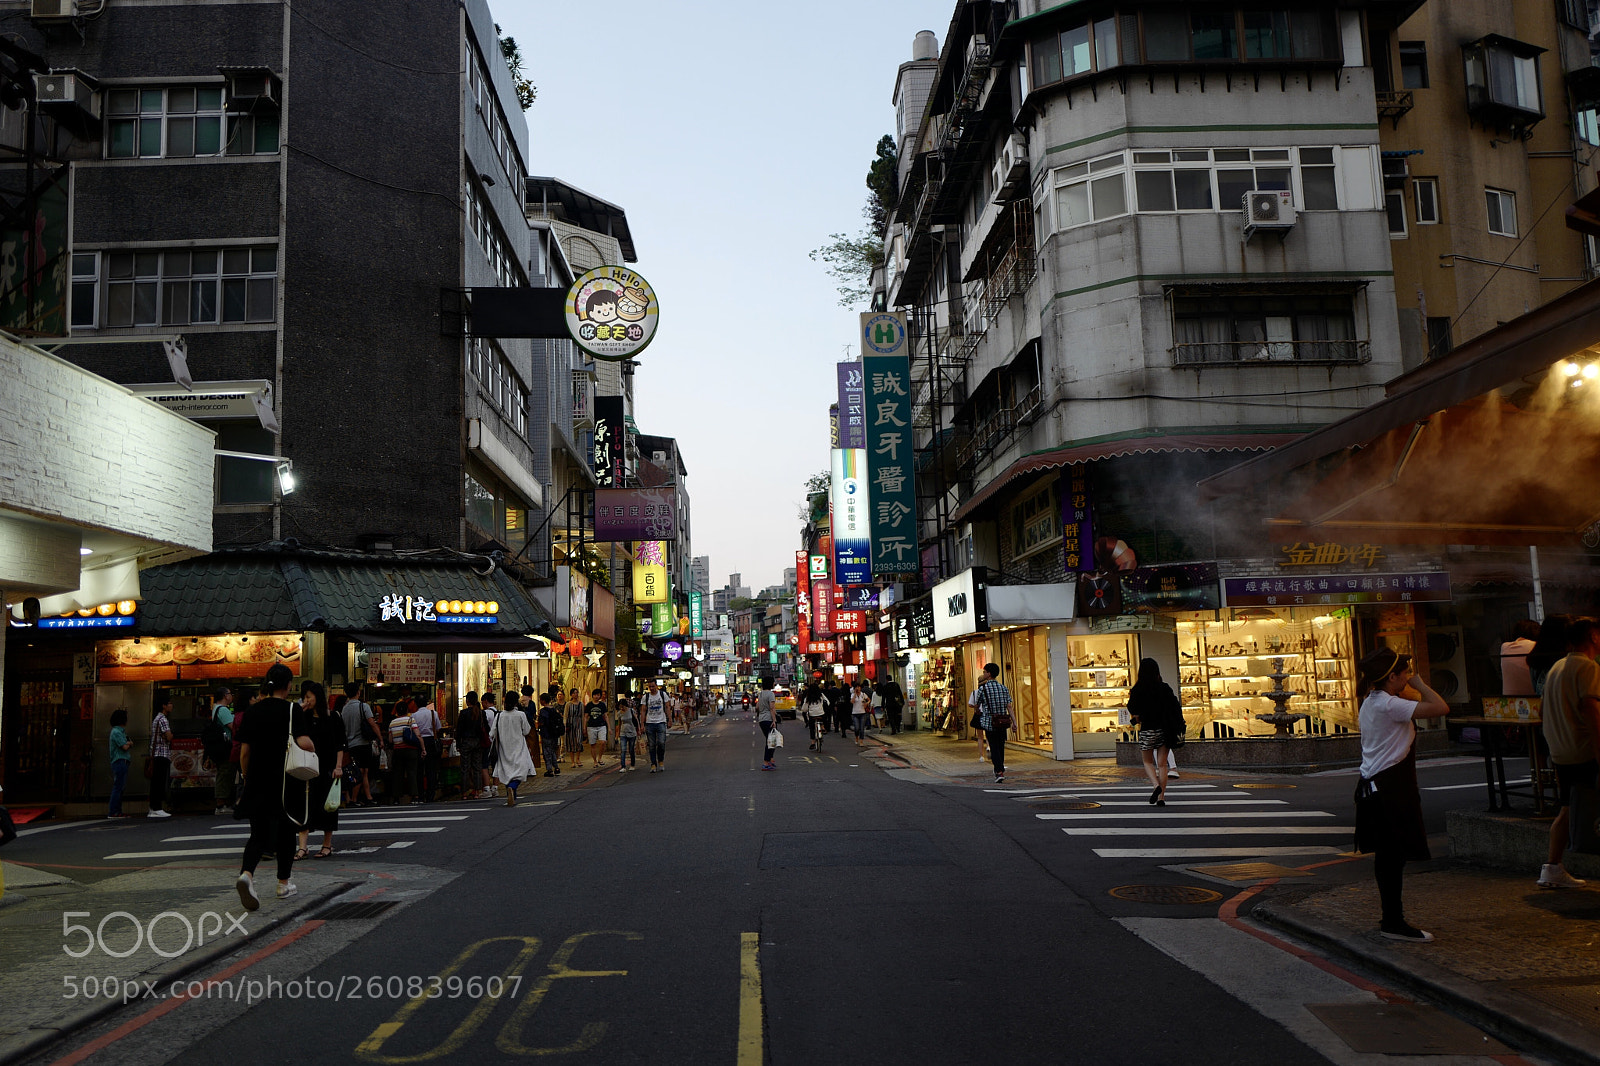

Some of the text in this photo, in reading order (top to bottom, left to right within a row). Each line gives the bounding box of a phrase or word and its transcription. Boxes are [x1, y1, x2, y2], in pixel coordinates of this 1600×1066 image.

[612, 270, 640, 287] Hello
[580, 325, 642, 339] 收藏天地
[872, 371, 913, 561] 誠良牙醫診所
[1064, 522, 1080, 568] 群星會
[874, 562, 917, 572] 2393-6306
[645, 573, 655, 597] 百貨
[1245, 576, 1431, 592] 經典流行歌曲 回顧往日情懷
[378, 593, 437, 624] 誠記
